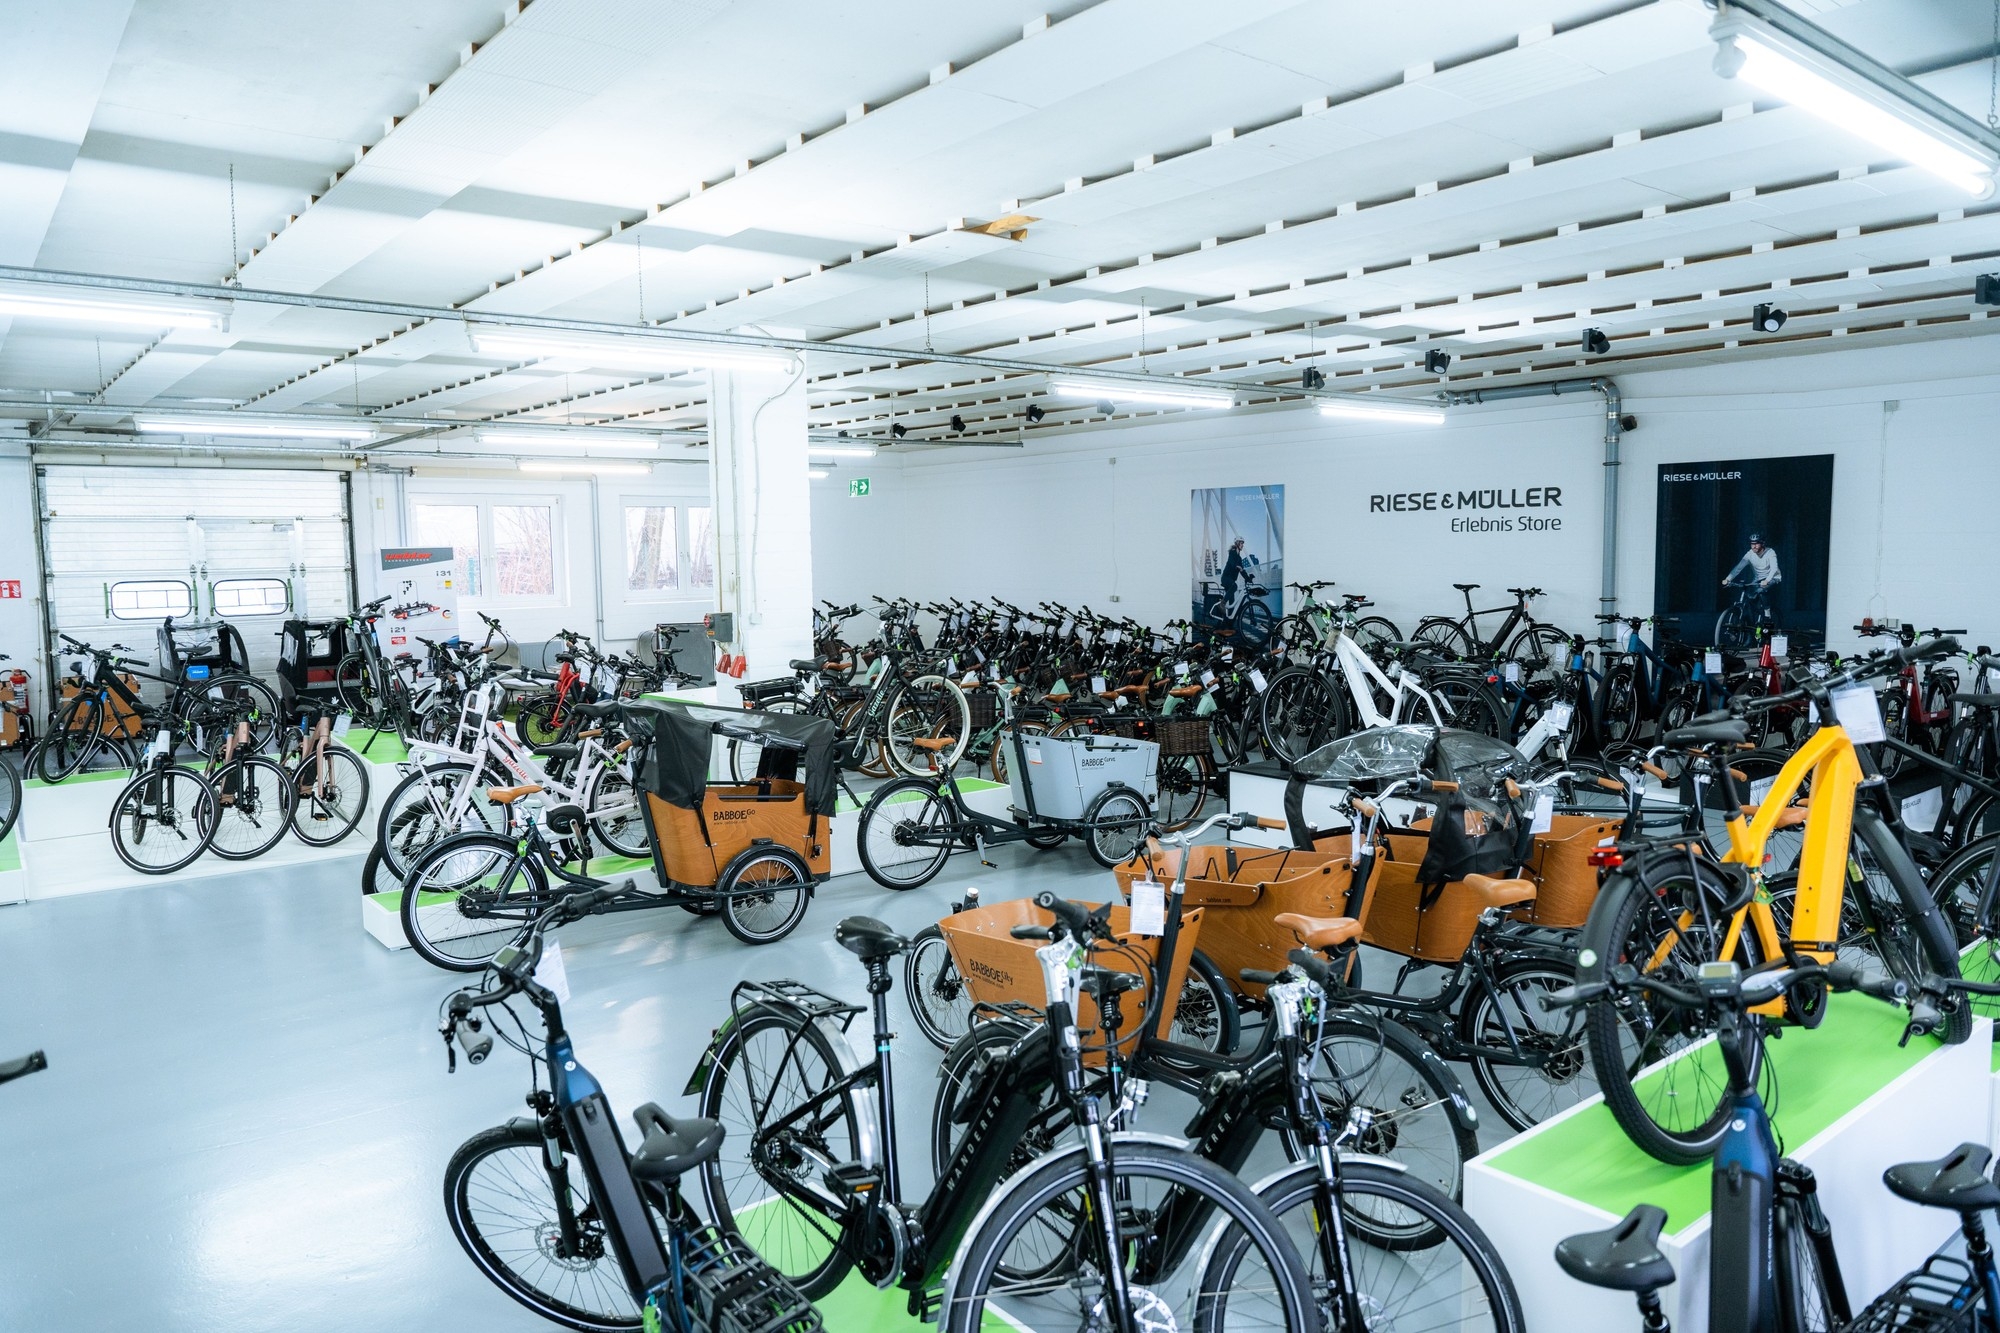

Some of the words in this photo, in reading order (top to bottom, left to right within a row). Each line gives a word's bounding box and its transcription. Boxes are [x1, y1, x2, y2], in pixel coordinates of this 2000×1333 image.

[1663, 473, 1692, 482] RIESE
[1700, 472, 1742, 480] MÜLLER
[1370, 492, 1437, 512] RIESE
[1441, 493, 1454, 509] &
[1457, 486, 1562, 510] MÜLLER
[1451, 516, 1513, 532] Erlebnis
[1518, 516, 1562, 532] Store
[714, 810, 747, 820] BABBOE
[970, 958, 1003, 983] BABBOE
[1001, 970, 1013, 986] City
[946, 1096, 1000, 1191] WANDERER
